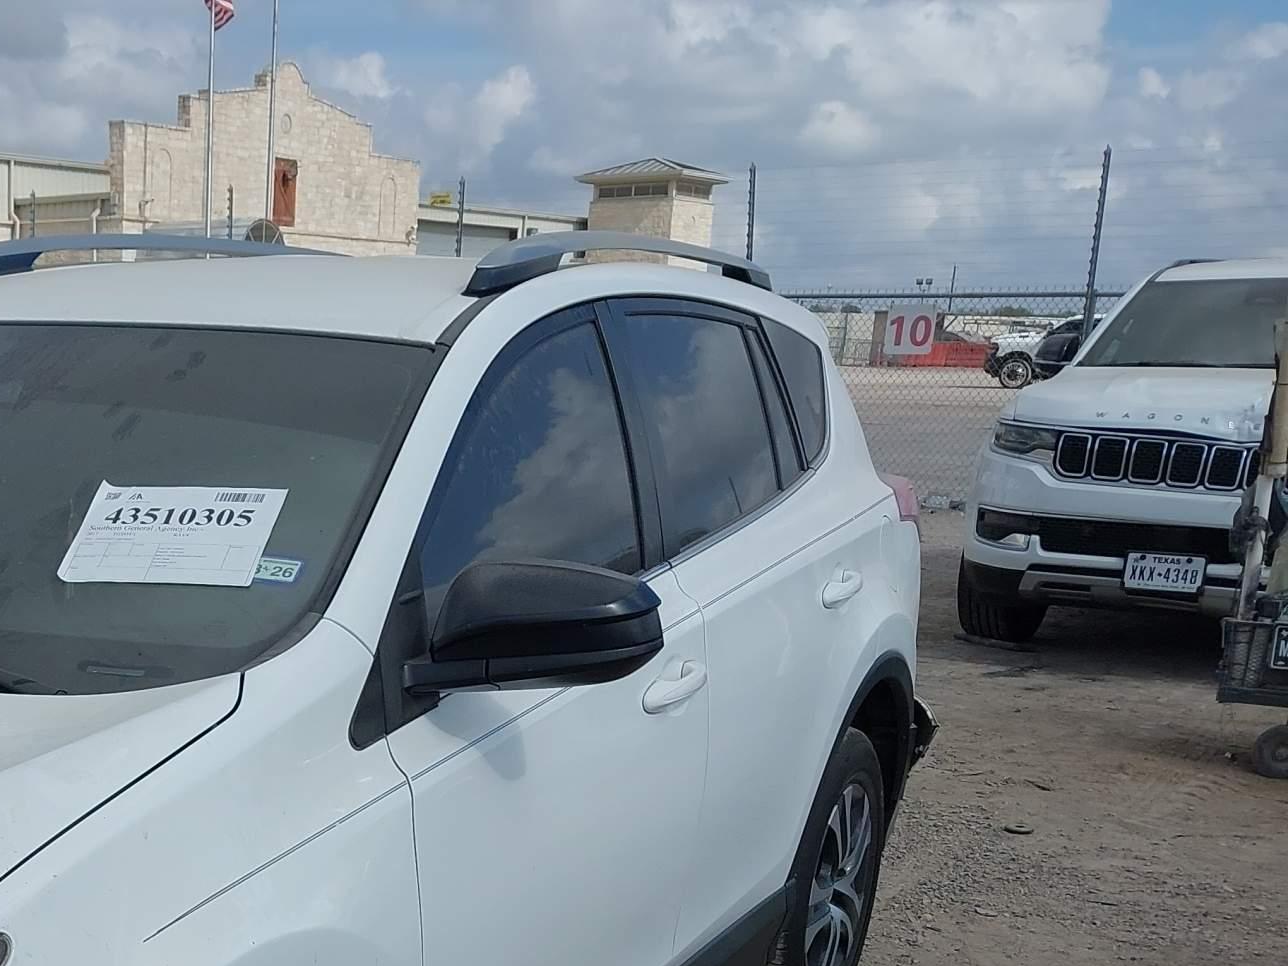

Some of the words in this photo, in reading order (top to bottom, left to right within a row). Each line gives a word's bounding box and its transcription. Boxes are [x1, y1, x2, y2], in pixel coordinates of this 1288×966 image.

[889, 314, 932, 347] 10
[105, 507, 256, 527] 43510305
[1153, 556, 1181, 565] TEXAS
